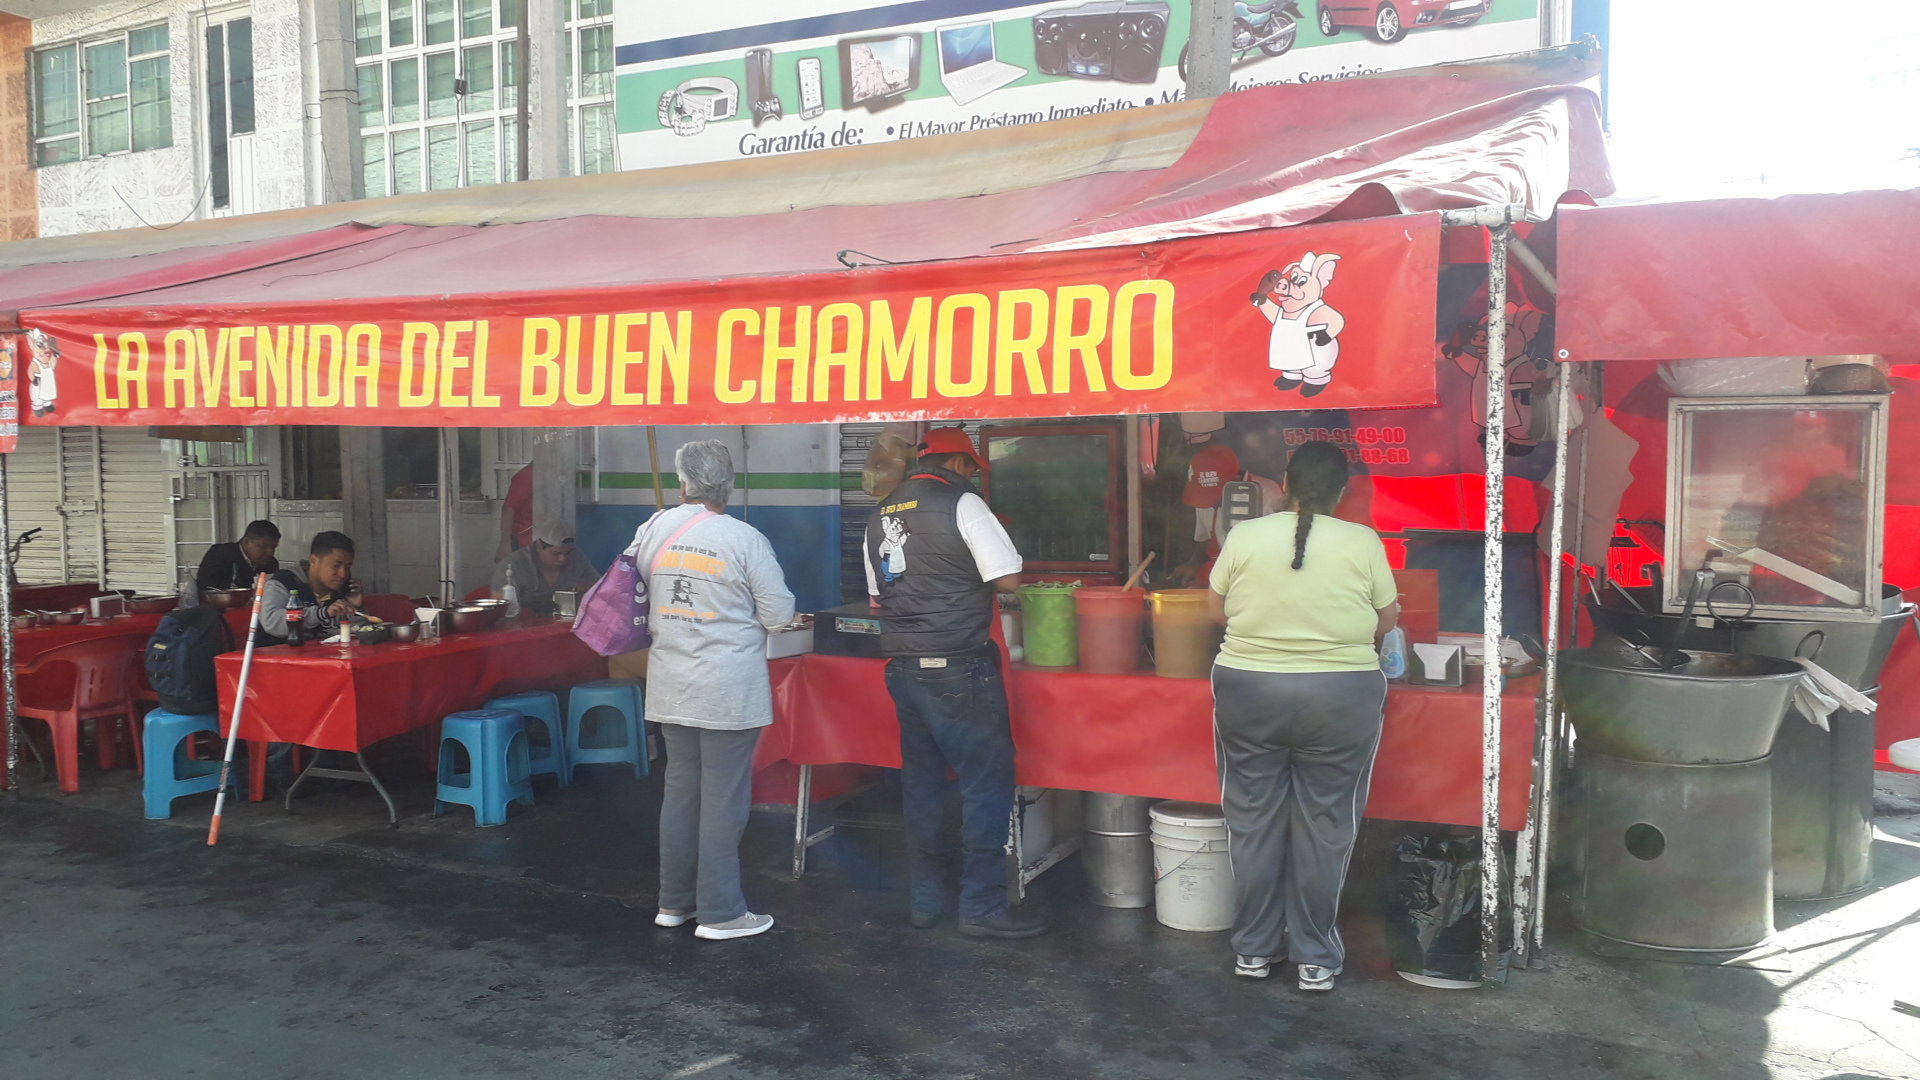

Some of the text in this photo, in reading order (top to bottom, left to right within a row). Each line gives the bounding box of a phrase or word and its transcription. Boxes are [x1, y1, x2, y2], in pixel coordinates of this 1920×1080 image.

[738, 121, 864, 156] Garantía de:
[898, 121, 914, 140] El
[969, 112, 1043, 131] Préstamo
[93, 279, 1176, 409] LA AVENIDA DEL BUEN CHAMORRO
[1283, 426, 1406, 445] 55-76-91-49-00
